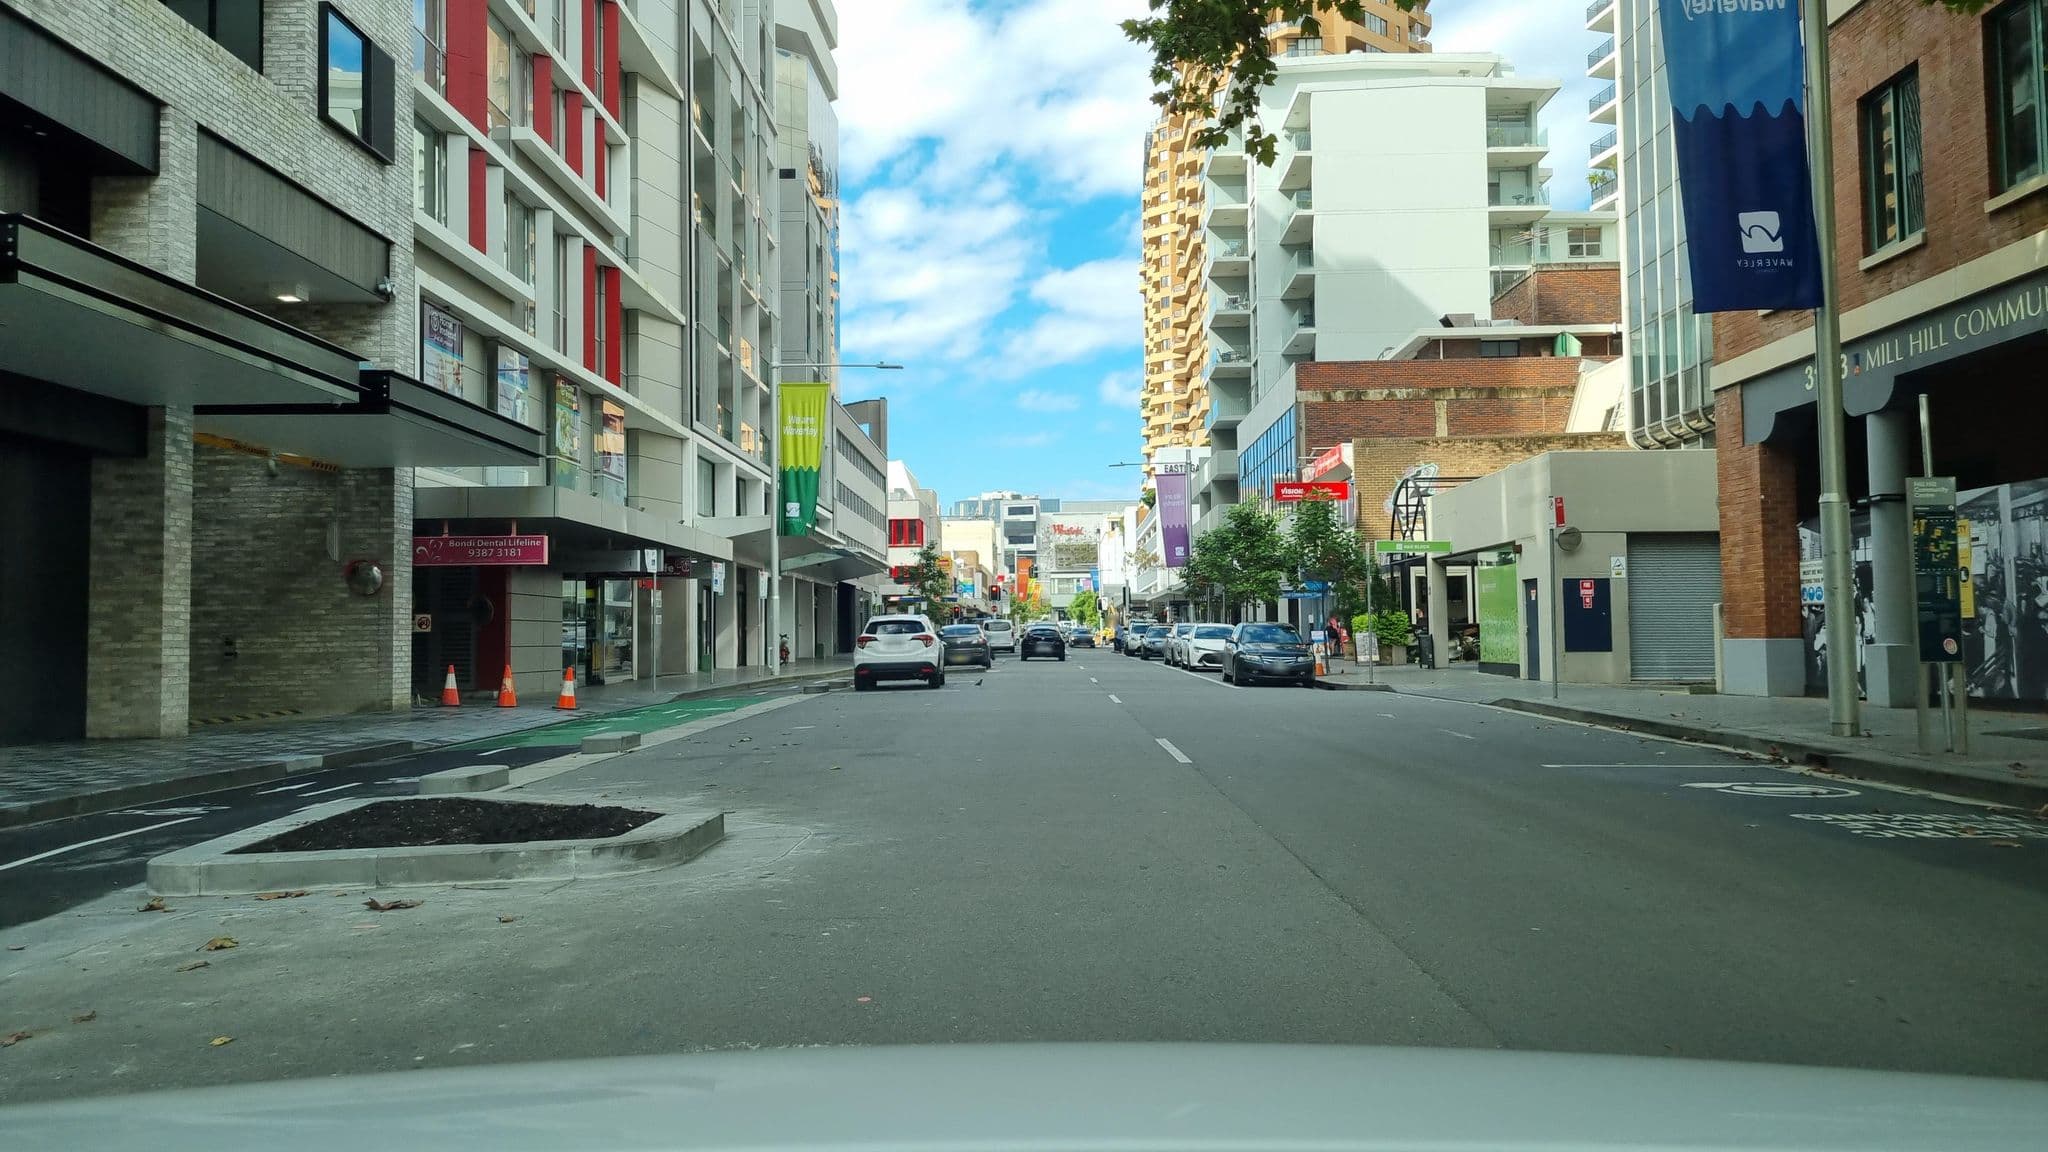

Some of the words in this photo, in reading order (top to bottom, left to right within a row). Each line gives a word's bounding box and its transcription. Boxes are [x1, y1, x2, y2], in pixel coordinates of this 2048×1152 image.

[1866, 339, 1904, 371] MILL
[1909, 322, 1949, 356] HILL
[783, 425, 818, 438] Waverley
[1052, 524, 1086, 535] Westfield
[449, 539, 475, 547] Bondi
[478, 539, 507, 547] Dental
[509, 538, 541, 547] Lifeline
[468, 548, 494, 558] 9387
[496, 548, 521, 557] 3181
